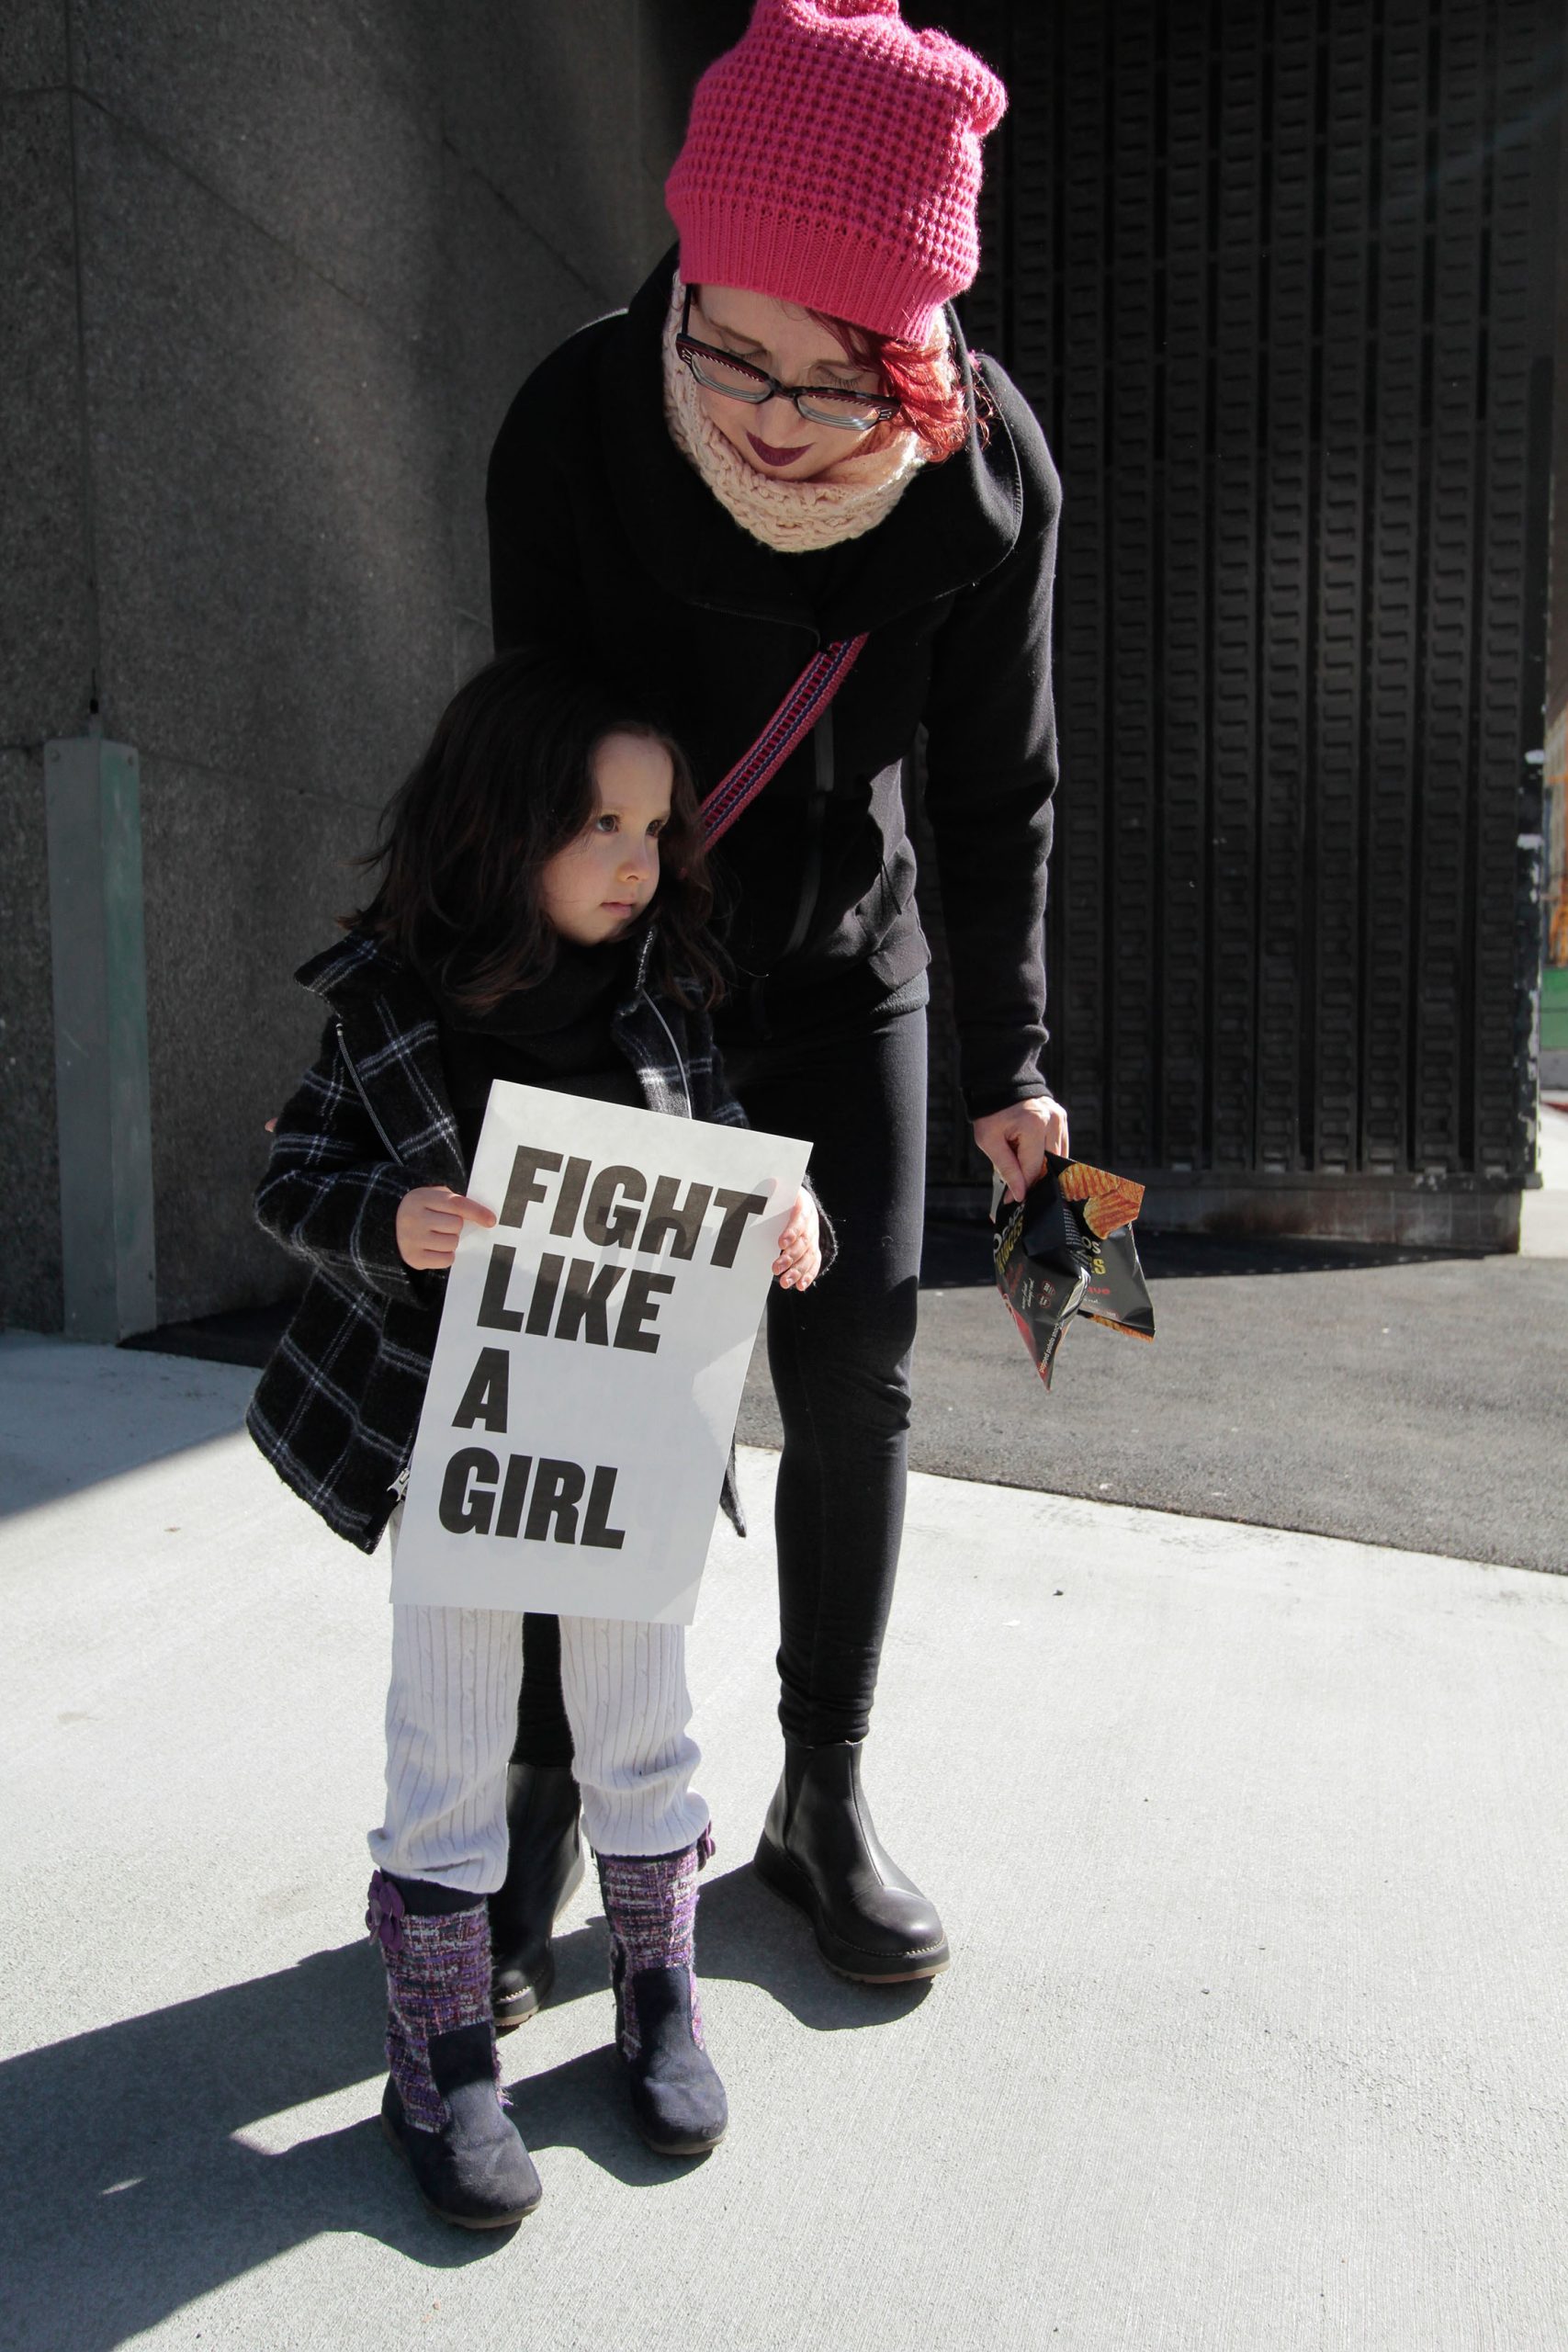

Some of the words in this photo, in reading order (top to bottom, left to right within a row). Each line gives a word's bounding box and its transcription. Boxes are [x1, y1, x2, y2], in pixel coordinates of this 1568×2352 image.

[498, 1144, 769, 1269] FIGHT
[476, 1243, 676, 1353] LIKE
[451, 1346, 510, 1433] A
[438, 1446, 626, 1550] GIRL
